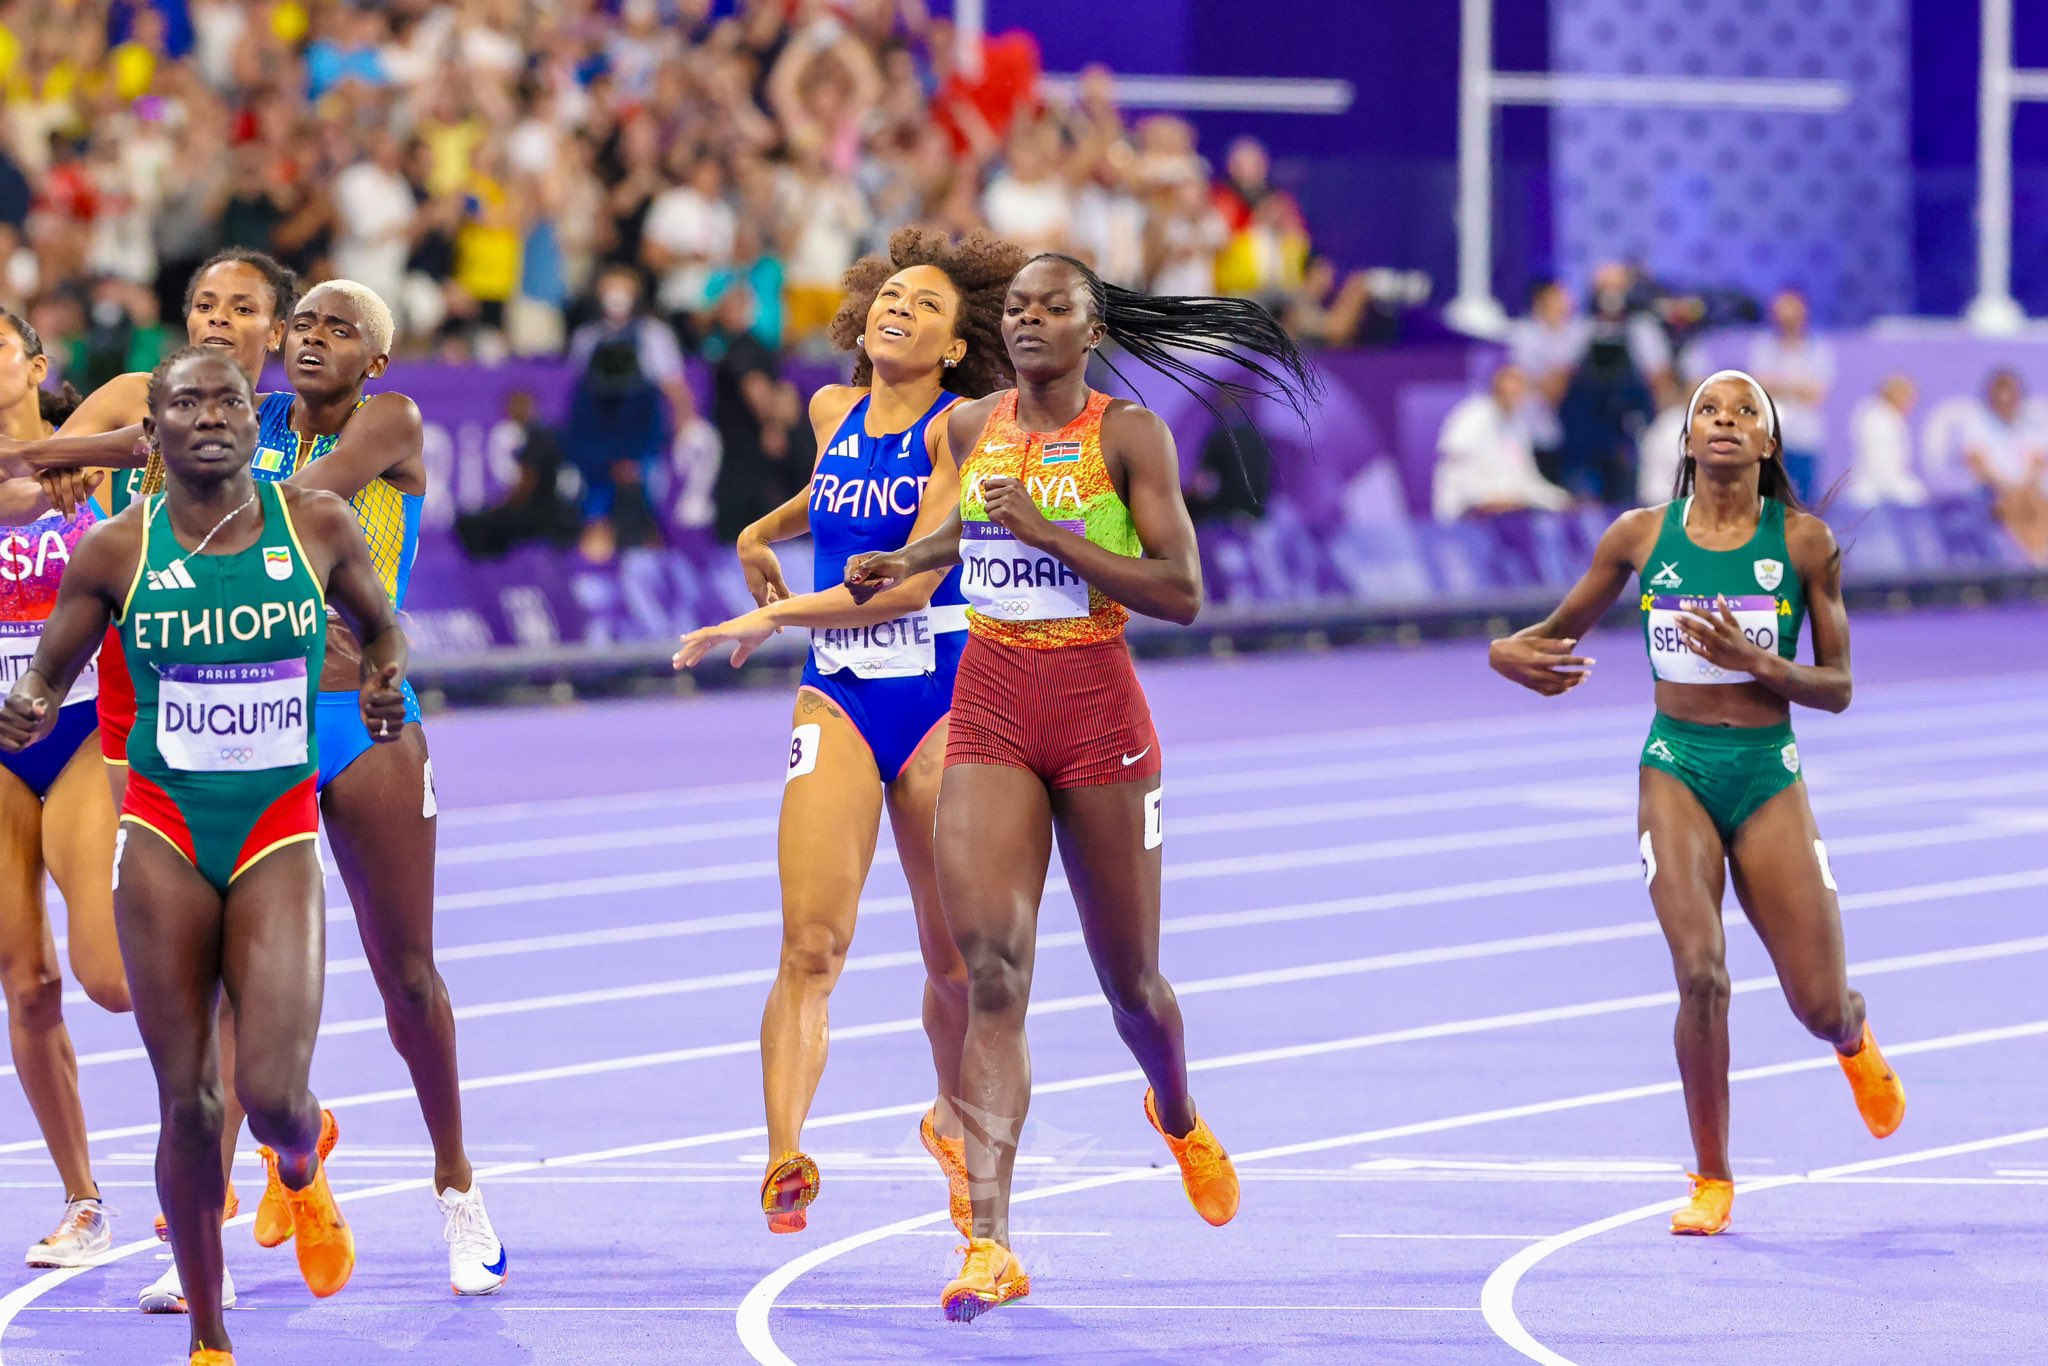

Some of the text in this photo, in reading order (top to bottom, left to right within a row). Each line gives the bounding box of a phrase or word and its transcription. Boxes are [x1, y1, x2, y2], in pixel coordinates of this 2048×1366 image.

[967, 472, 1083, 509] KYA
[135, 598, 317, 649] ETHIOPIA
[198, 668, 275, 680] PARIS 2024
[165, 697, 302, 736] DUGUMA
